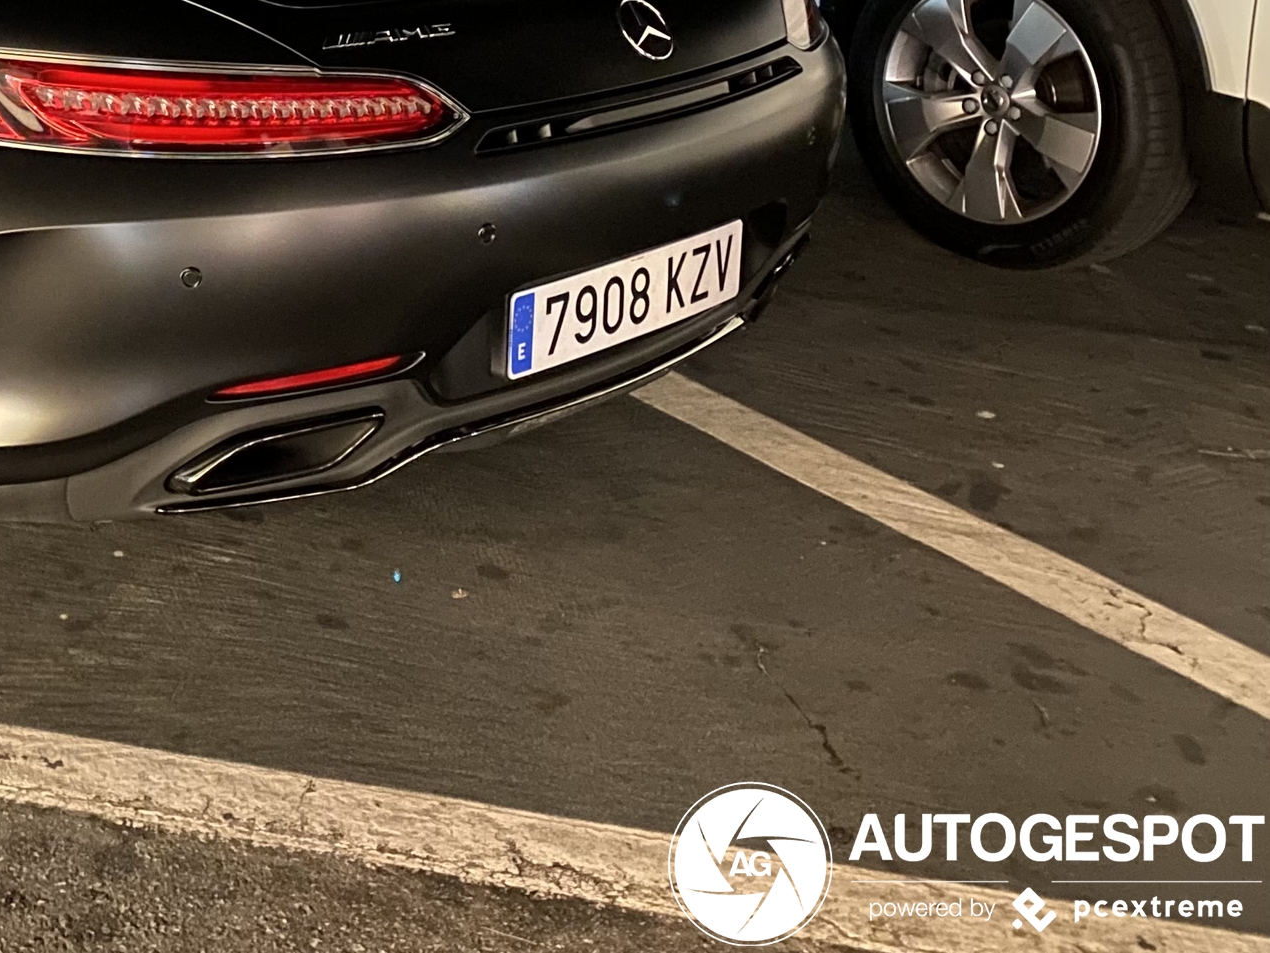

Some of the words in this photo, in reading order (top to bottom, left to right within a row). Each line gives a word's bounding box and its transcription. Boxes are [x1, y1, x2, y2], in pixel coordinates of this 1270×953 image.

[545, 266, 651, 356] 7908
[665, 234, 734, 314] KZV
[517, 342, 527, 361] E
